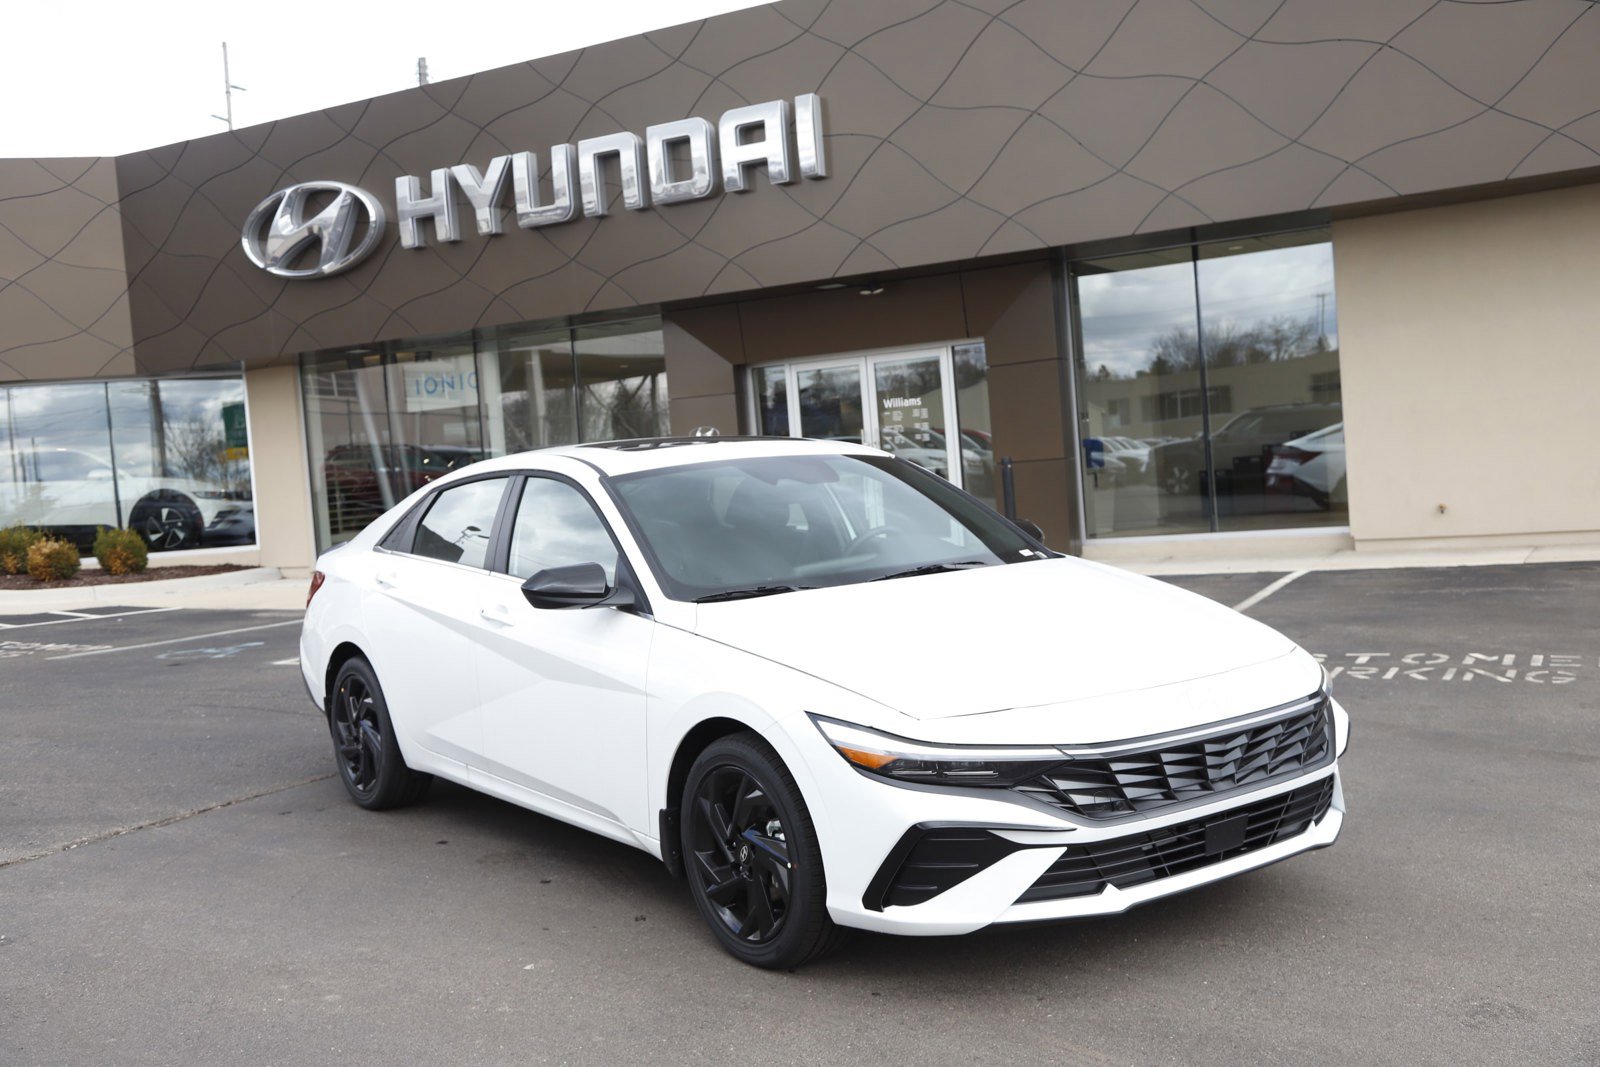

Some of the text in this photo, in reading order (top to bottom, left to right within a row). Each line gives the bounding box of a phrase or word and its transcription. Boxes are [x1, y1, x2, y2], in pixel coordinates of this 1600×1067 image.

[395, 93, 828, 250] HYUNDAI
[883, 397, 922, 409] Williams
[1312, 652, 1600, 667] TOME
[1330, 666, 1577, 684] RKING
